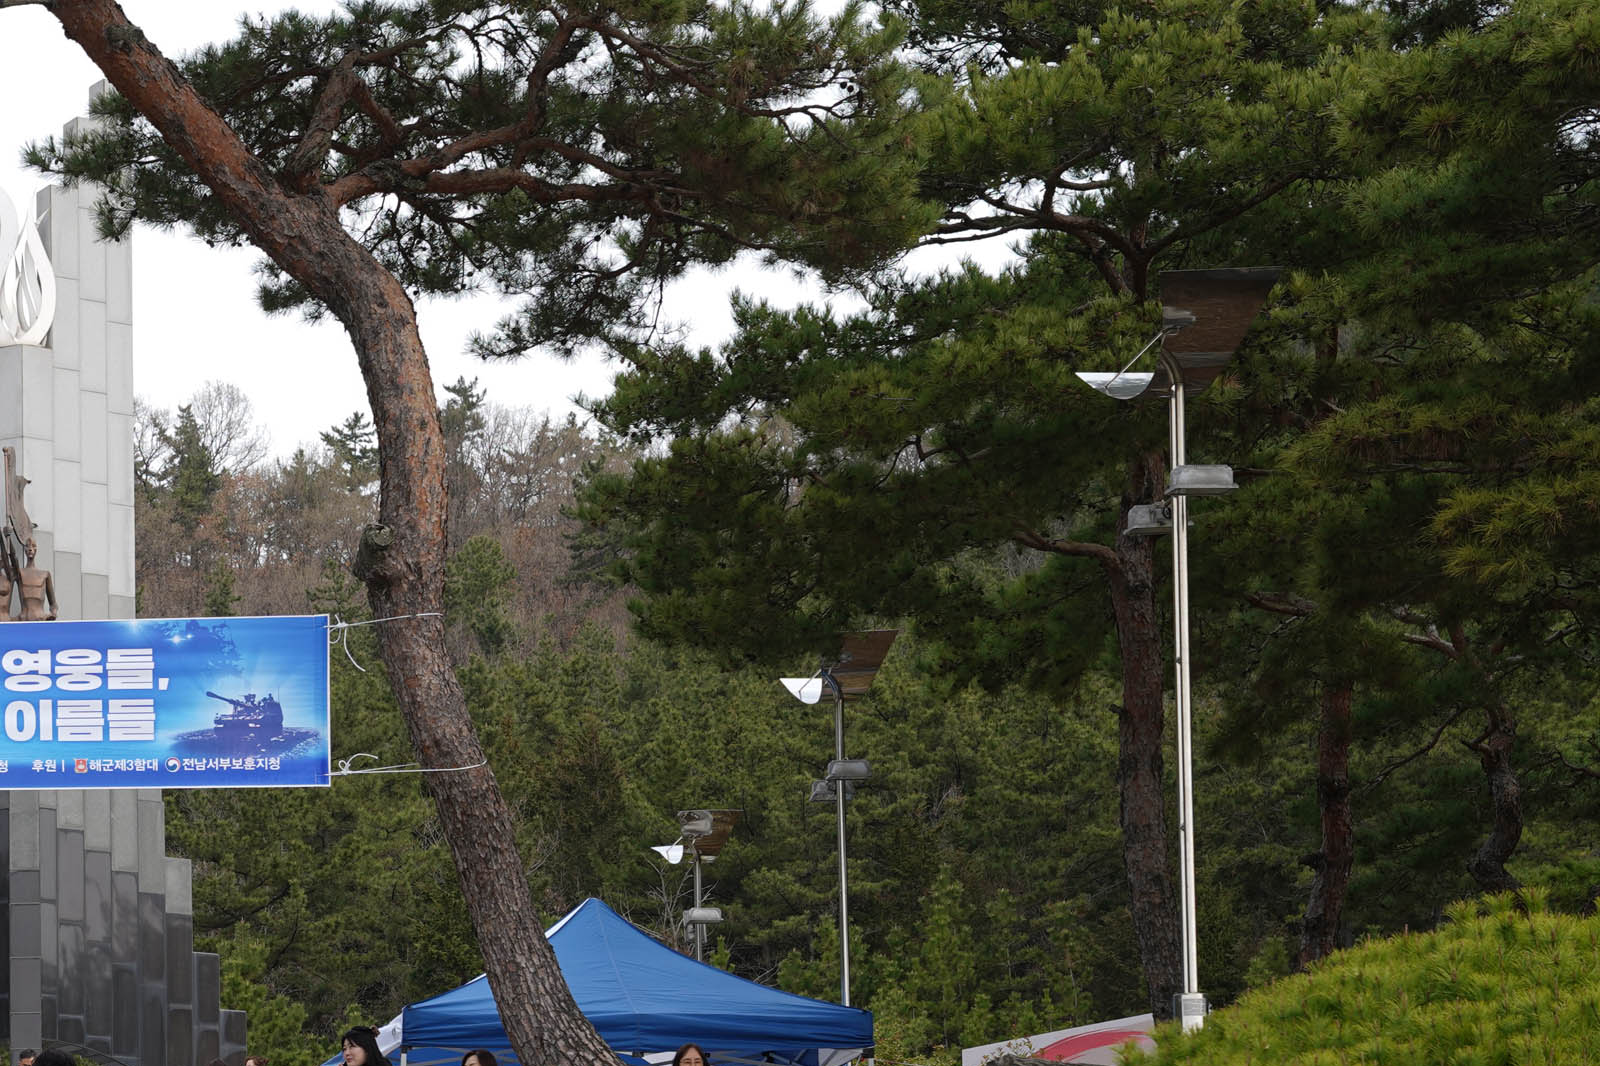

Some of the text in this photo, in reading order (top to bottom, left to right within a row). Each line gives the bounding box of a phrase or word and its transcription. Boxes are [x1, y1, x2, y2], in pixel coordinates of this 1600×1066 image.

[1, 647, 170, 692] 영웅들,
[4, 697, 156, 742] 이름들
[31, 756, 281, 773] 후원 해군제3함대 전남서부보훈지청
